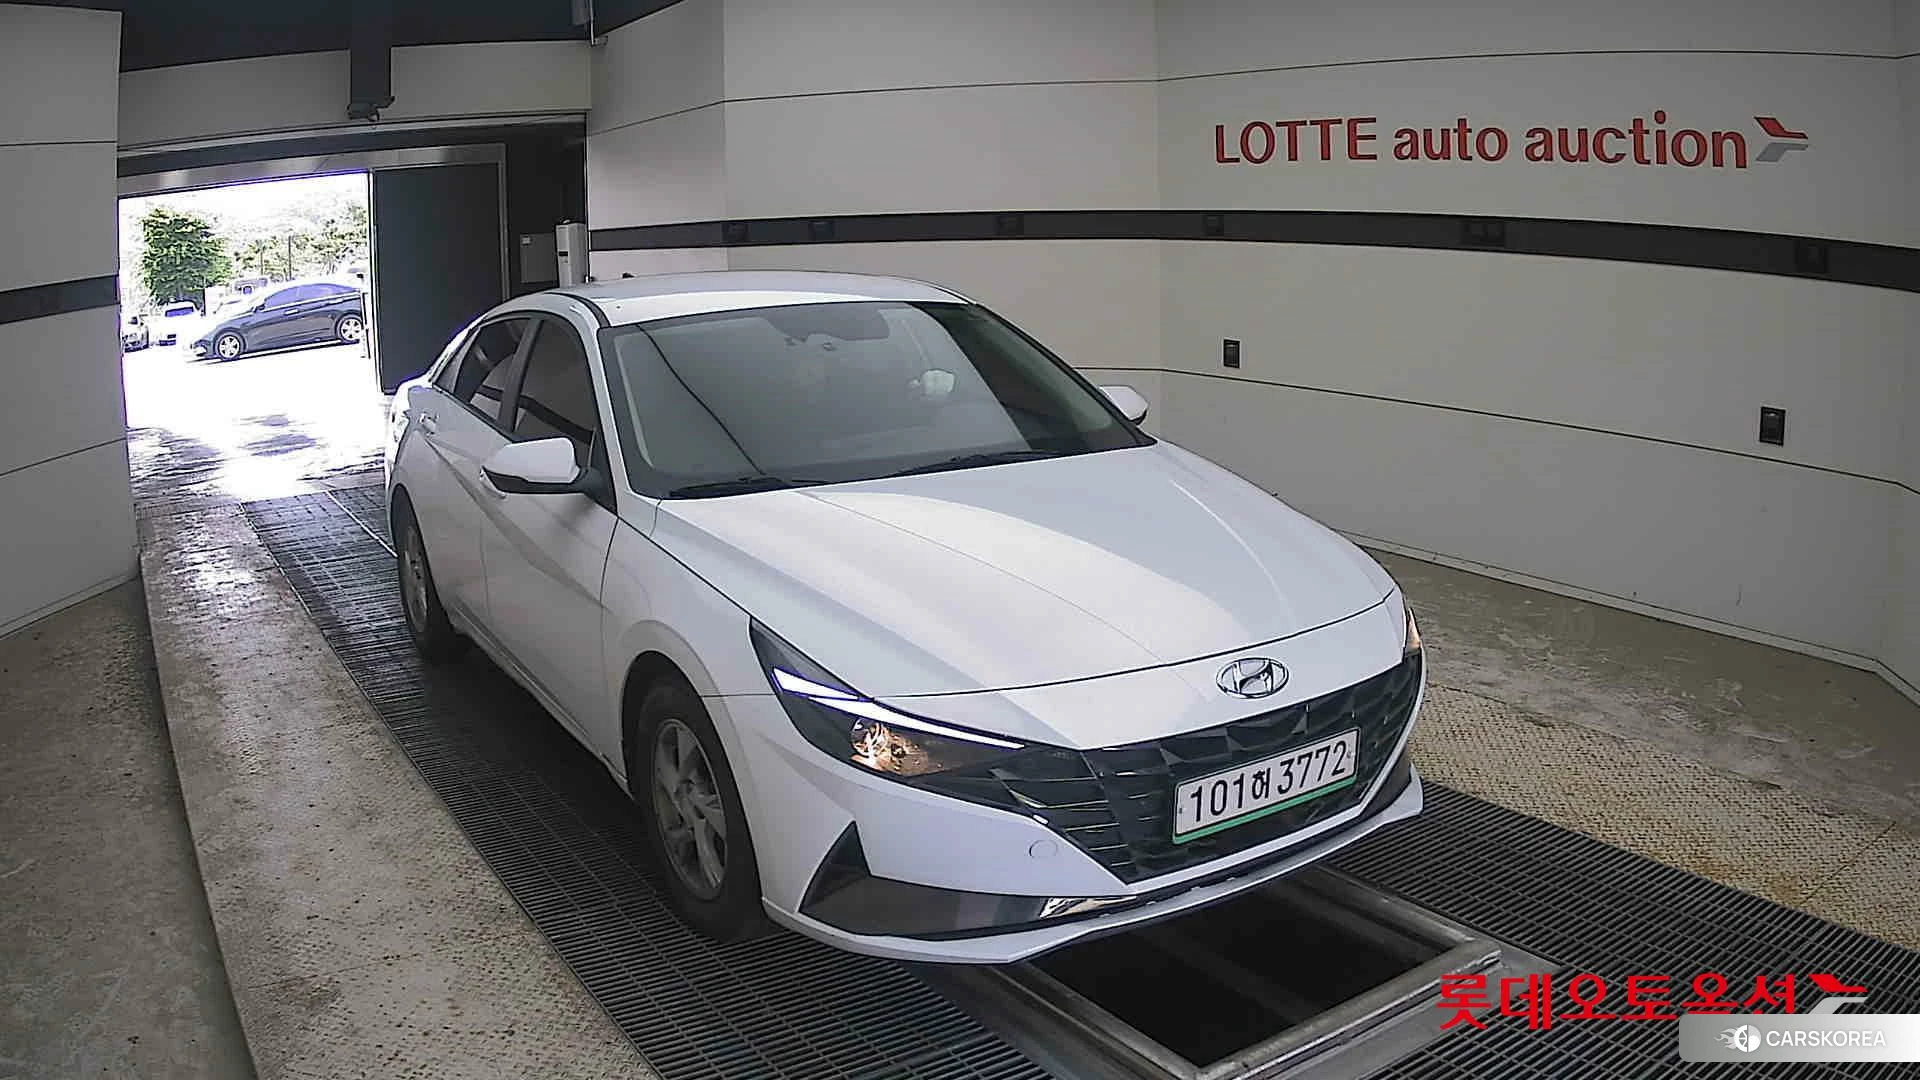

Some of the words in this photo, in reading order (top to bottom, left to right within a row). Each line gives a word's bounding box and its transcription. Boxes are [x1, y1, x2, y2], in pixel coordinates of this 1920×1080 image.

[1215, 117, 1377, 165] LOTTE
[1393, 117, 1508, 162] auto
[1523, 110, 1747, 168] auction
[1277, 740, 1347, 794] 3772
